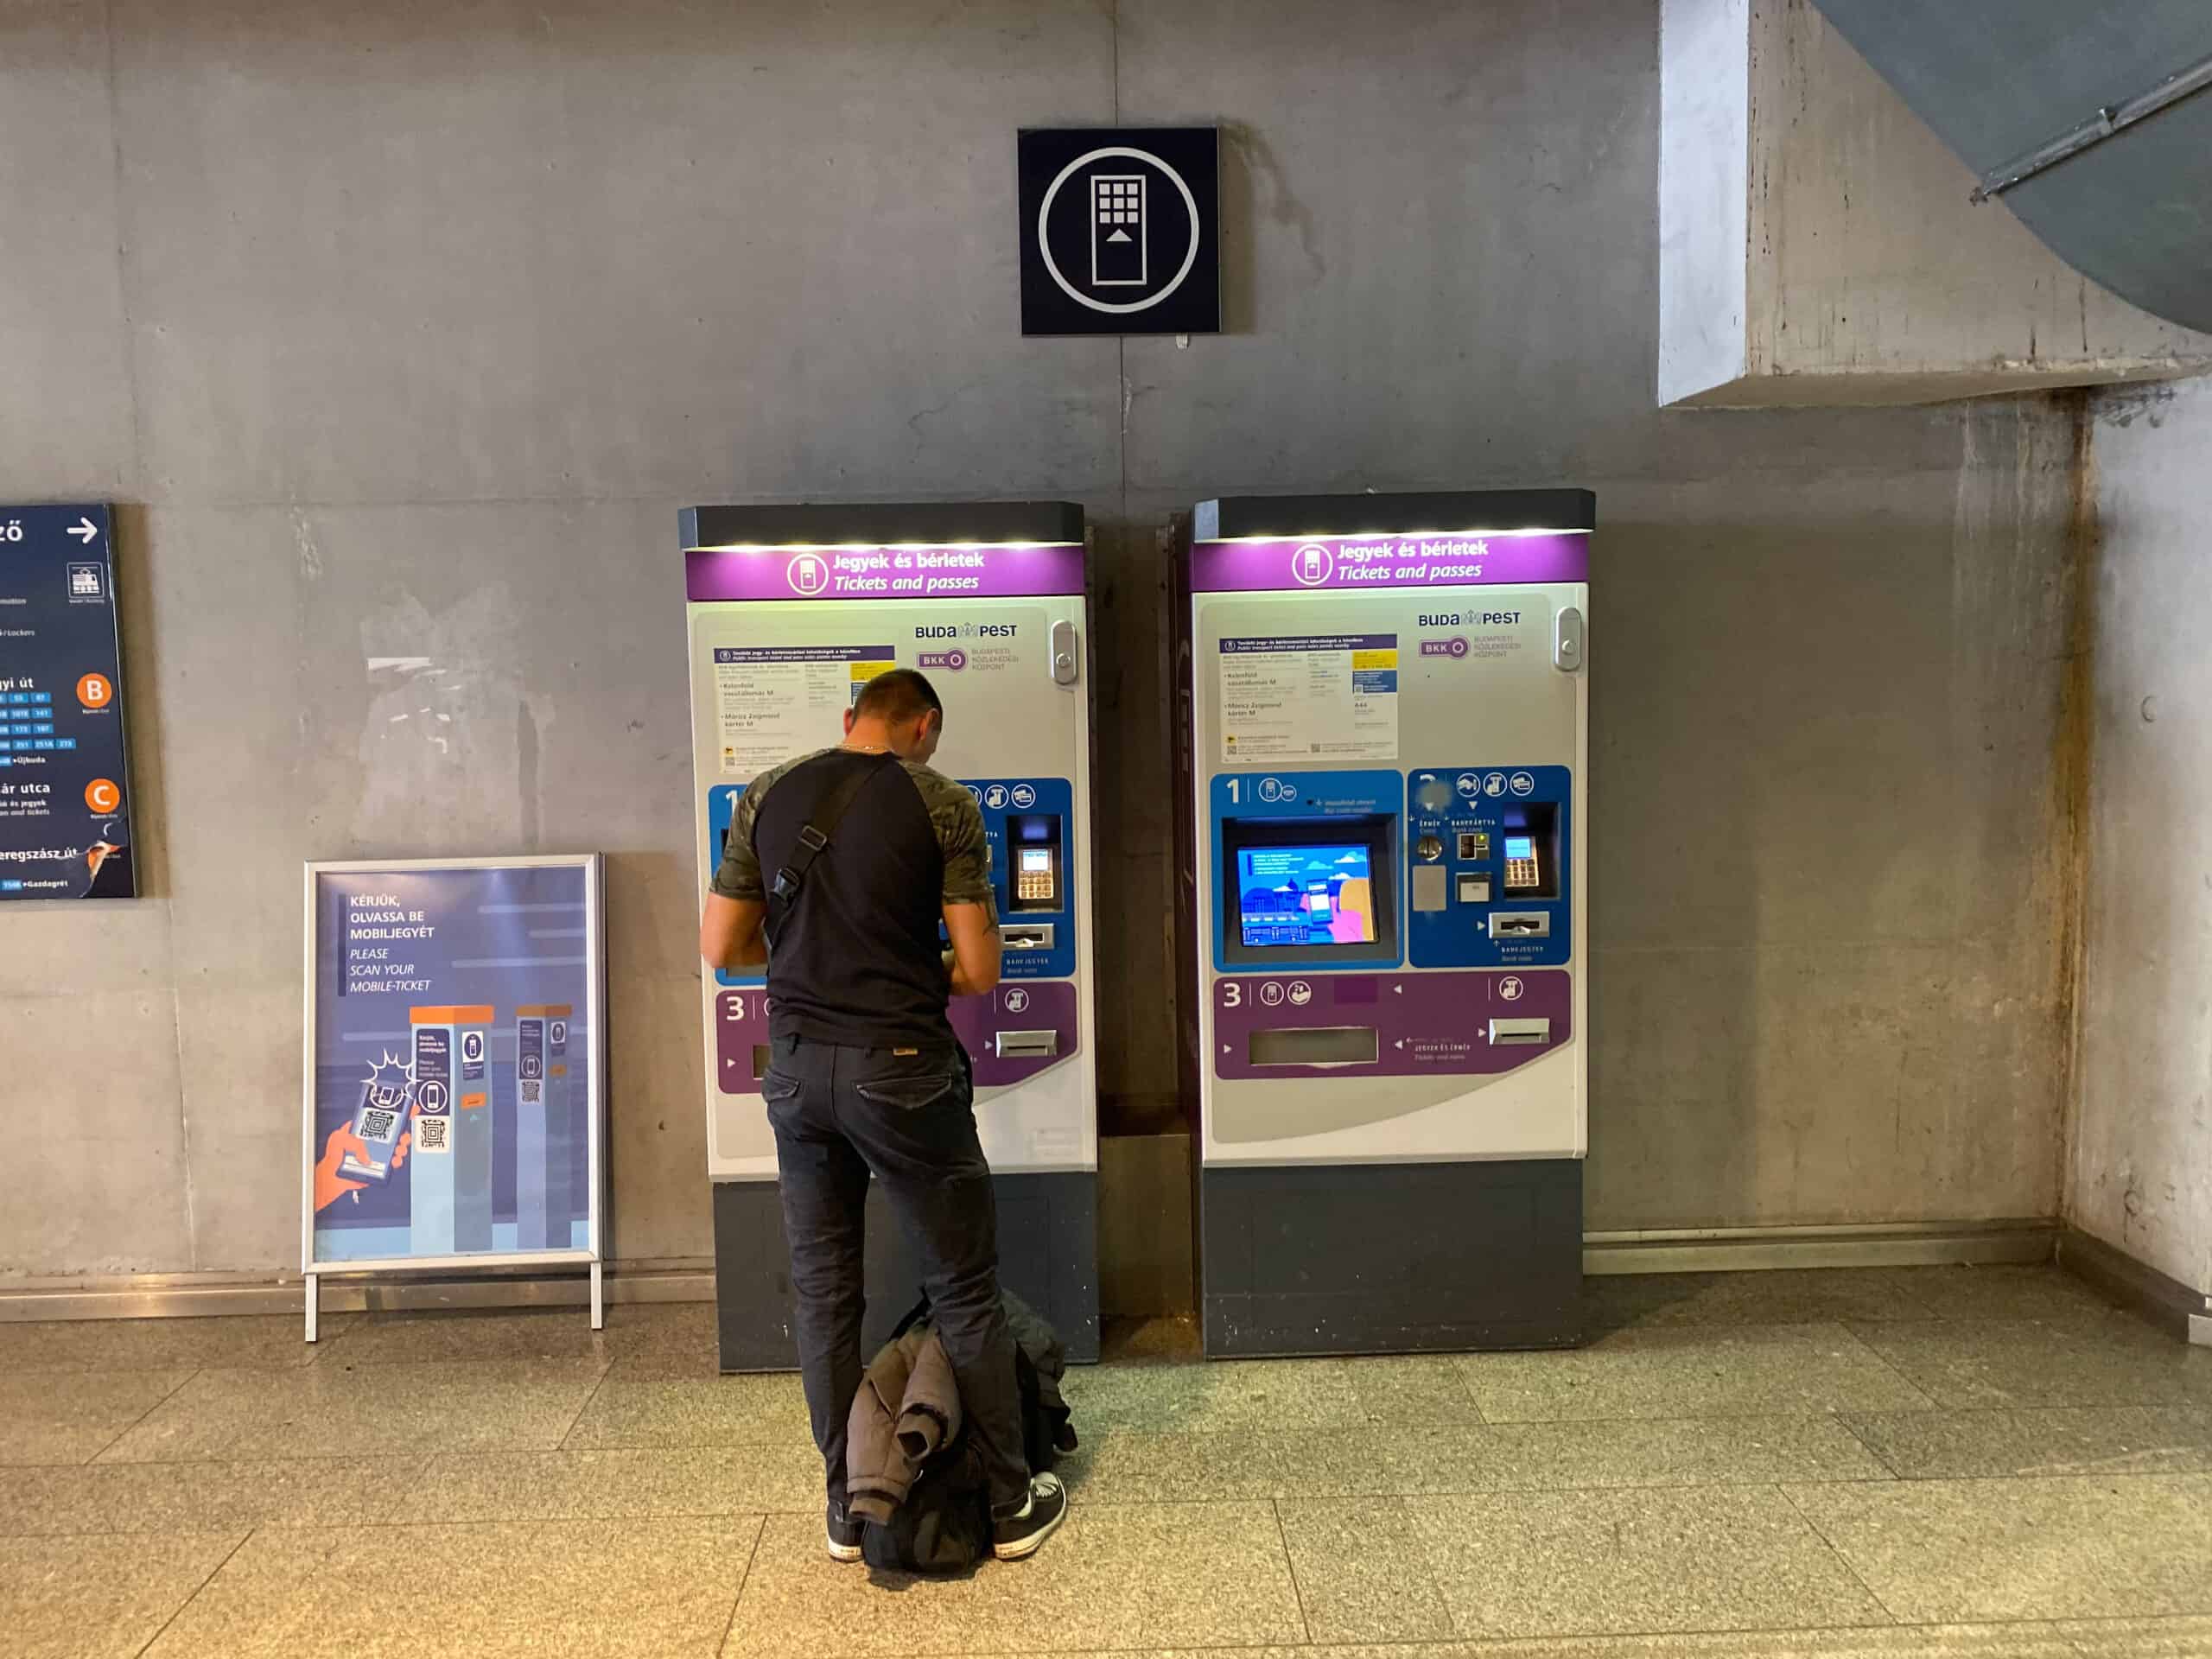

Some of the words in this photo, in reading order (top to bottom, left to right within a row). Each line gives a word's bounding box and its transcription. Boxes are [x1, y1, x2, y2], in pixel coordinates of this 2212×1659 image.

[1337, 543, 1394, 562] Jegyek
[1397, 542, 1416, 557] és
[1421, 539, 1489, 557] bérletek
[833, 553, 889, 573] Jegyek
[894, 553, 912, 569] és
[917, 552, 985, 569] bérletek
[1338, 564, 1391, 581] Tickets
[1395, 563, 1427, 579] and
[1429, 564, 1483, 581] passes
[834, 575, 888, 591] Tickets
[892, 575, 924, 590] and
[926, 577, 979, 594] passes
[1425, 644, 1447, 652] BKK
[923, 656, 945, 664] BKK
[0, 677, 15, 691] yi
[19, 677, 35, 689] út
[86, 680, 104, 701] B
[1, 783, 16, 794] ár
[20, 784, 51, 794] utca
[93, 785, 111, 805] C
[1226, 779, 1239, 804] 1
[21, 799, 47, 809] jegyek
[0, 847, 60, 862] eregszász
[350, 893, 400, 907] KÉRJÜK,
[350, 912, 405, 924] OLVASSA
[409, 911, 425, 922] BE
[350, 925, 435, 939] MOBILJEGYÉT
[350, 948, 390, 960] PLEASE
[349, 964, 381, 976] SCAN
[385, 963, 415, 975] YOUR
[350, 980, 432, 993] MOBILE-TICKET
[1222, 982, 1242, 1007] 3
[726, 995, 745, 1021] 3
